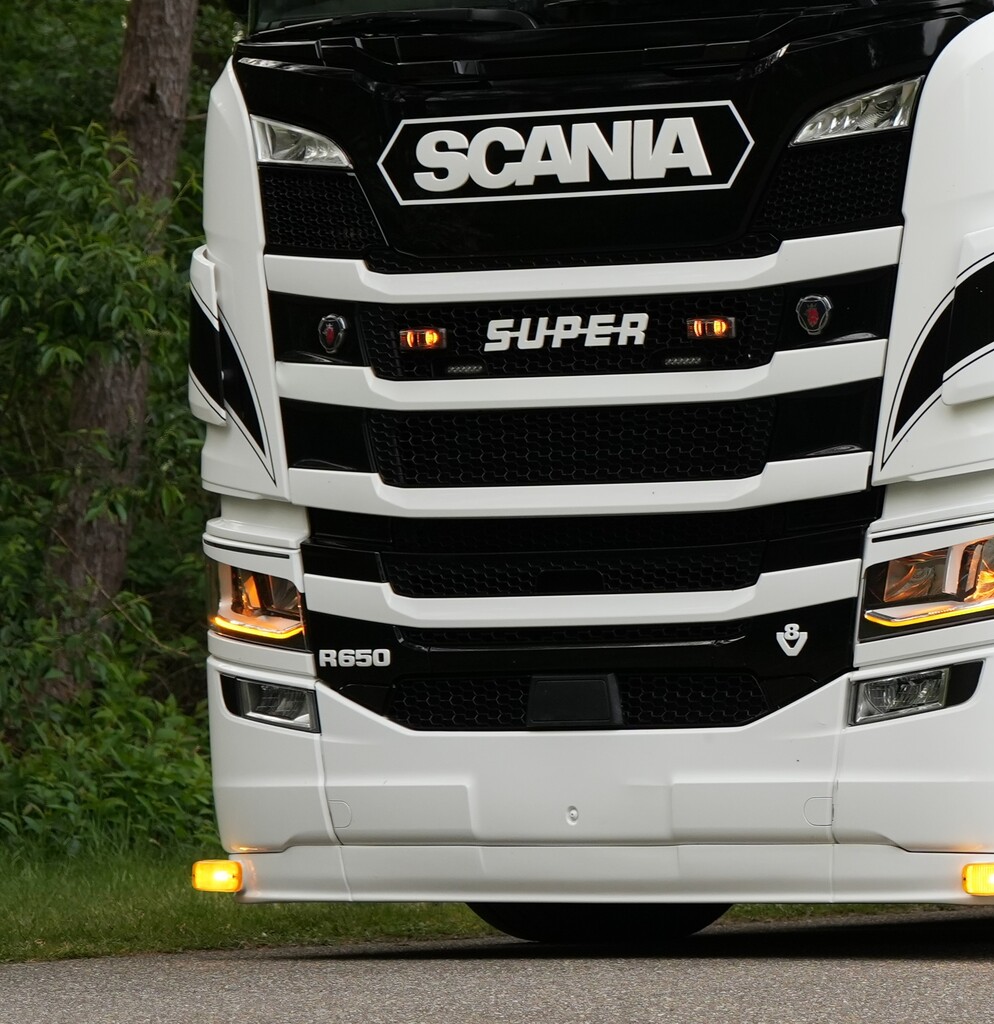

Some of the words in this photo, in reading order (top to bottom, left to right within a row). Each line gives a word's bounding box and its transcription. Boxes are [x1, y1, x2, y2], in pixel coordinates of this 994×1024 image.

[413, 116, 713, 193] SCANIA
[483, 312, 649, 352] SUPER
[318, 648, 391, 668] R650
